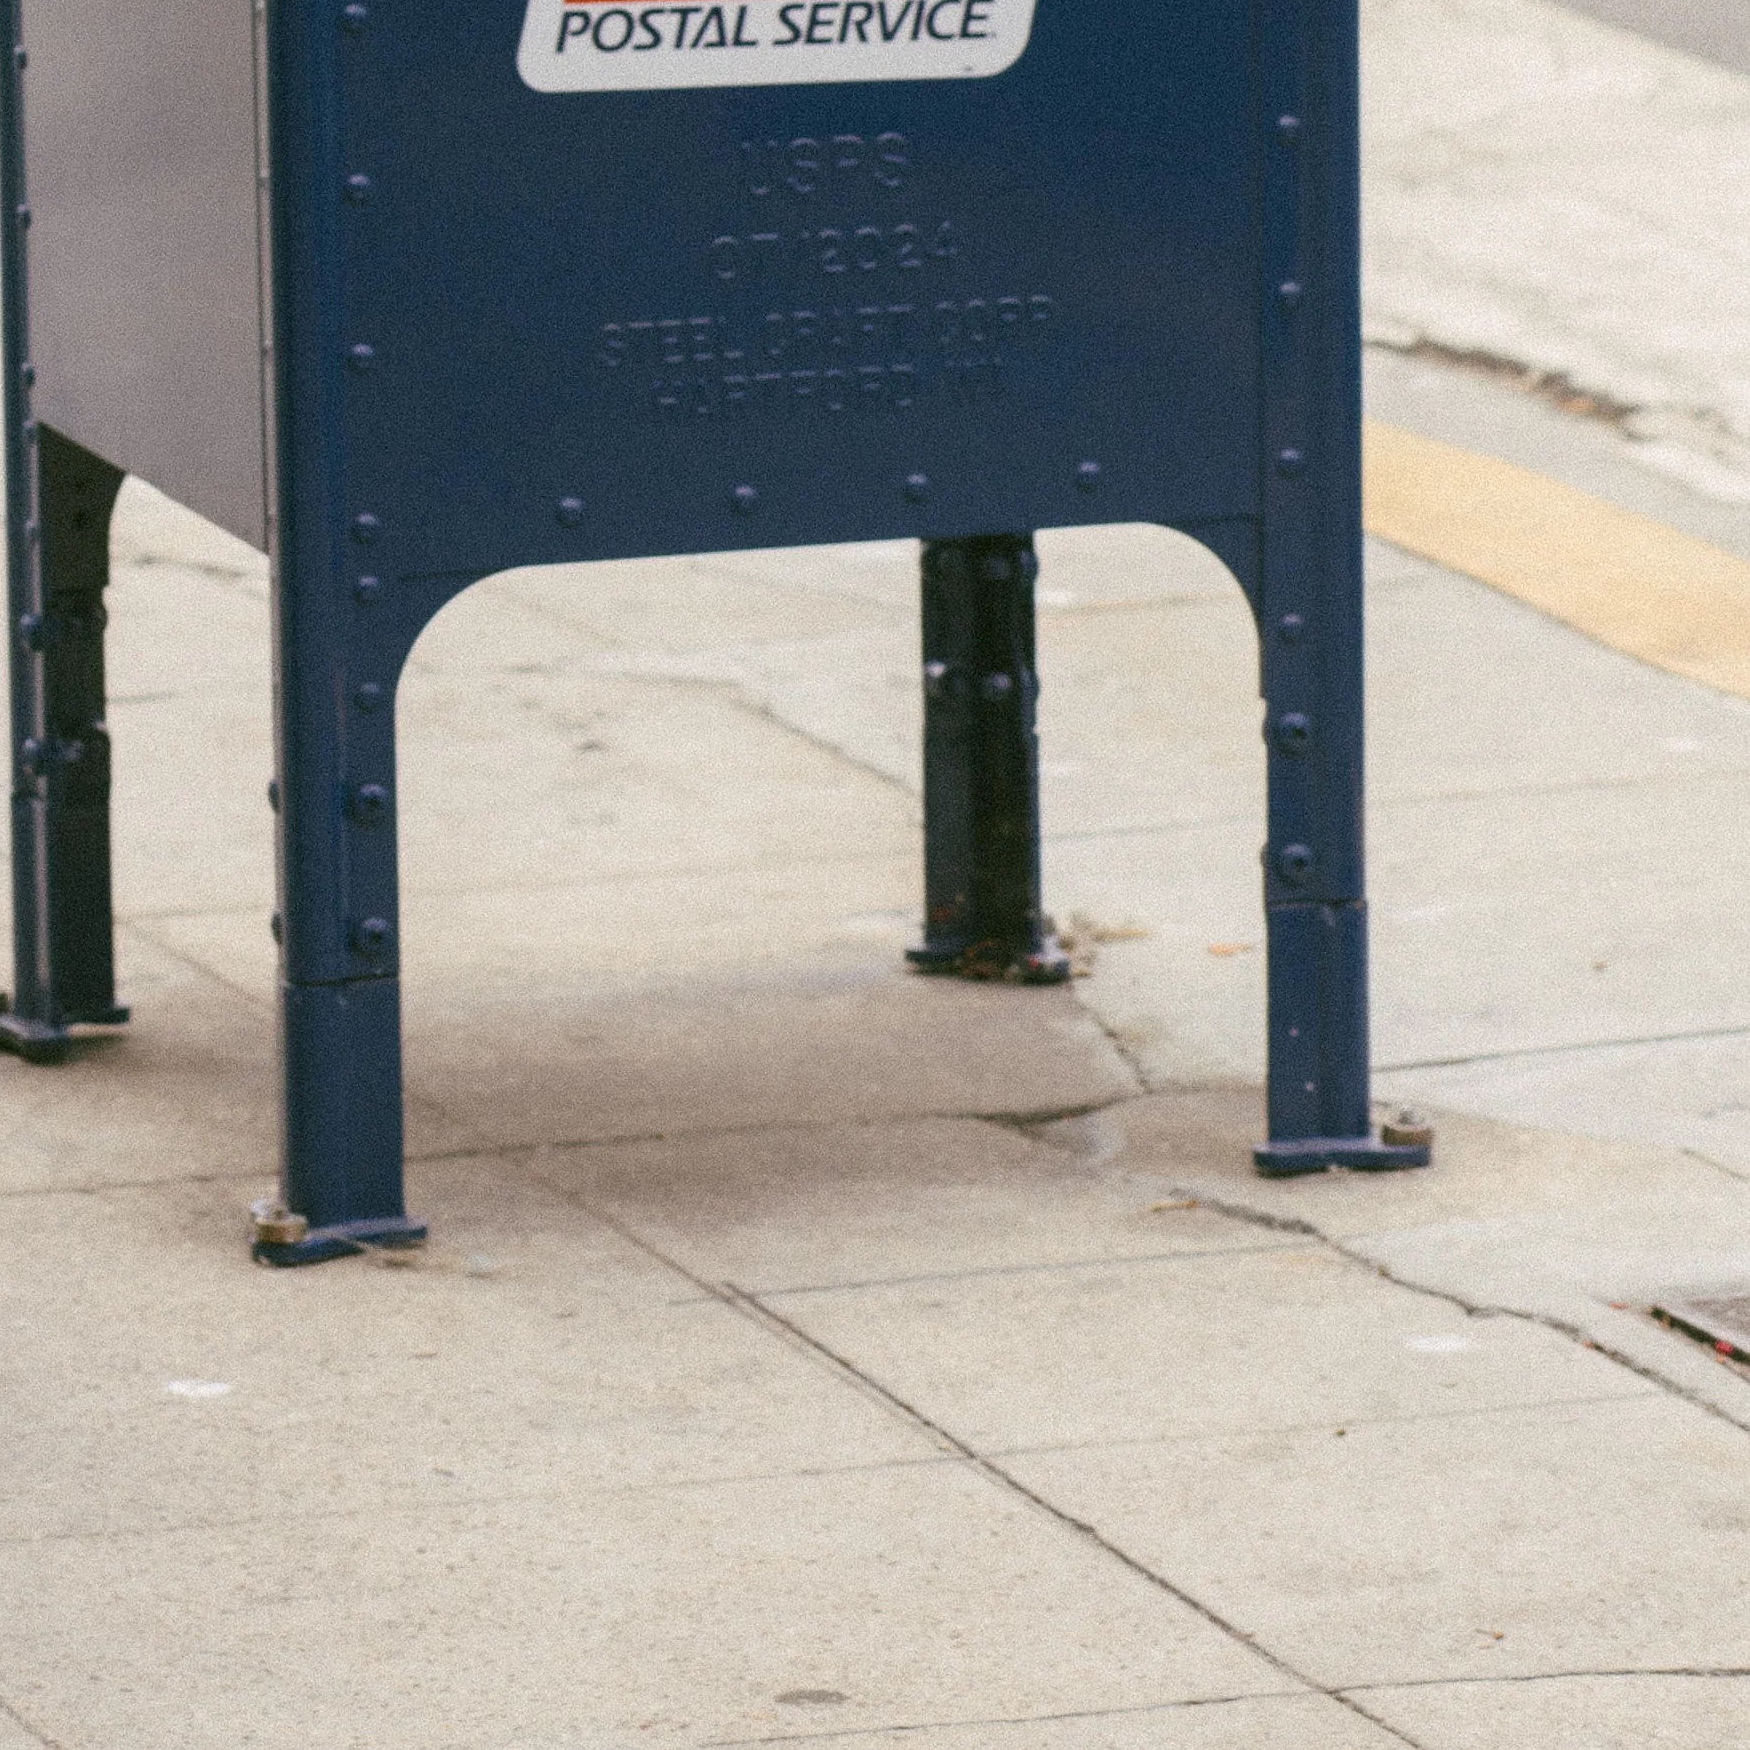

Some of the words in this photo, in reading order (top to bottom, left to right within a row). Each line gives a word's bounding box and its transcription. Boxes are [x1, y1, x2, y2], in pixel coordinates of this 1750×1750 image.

[554, 5, 758, 53] POSTAL
[740, 131, 908, 196] USPS
[598, 314, 745, 368] STEEL
